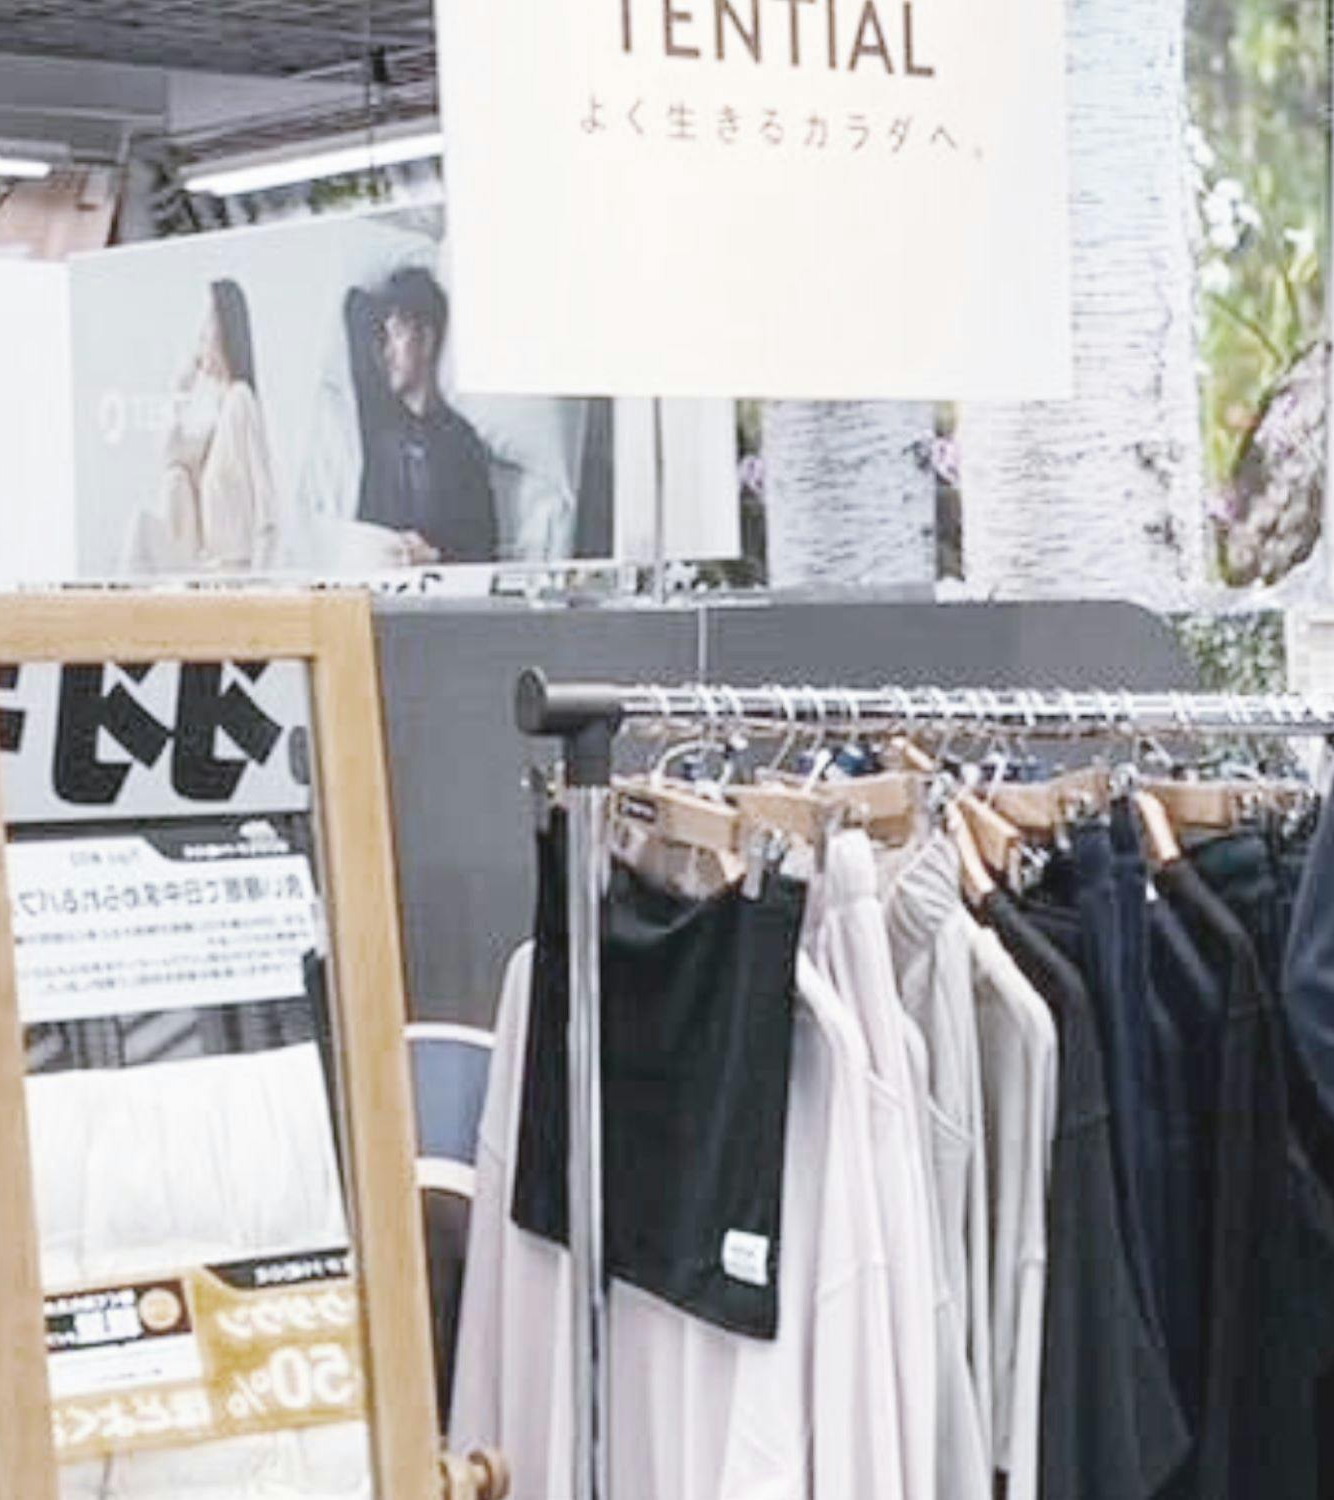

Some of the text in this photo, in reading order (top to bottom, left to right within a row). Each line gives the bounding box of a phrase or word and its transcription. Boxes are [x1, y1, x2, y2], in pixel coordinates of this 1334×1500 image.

[578, 95, 985, 159] よく生きるカラダへ。
